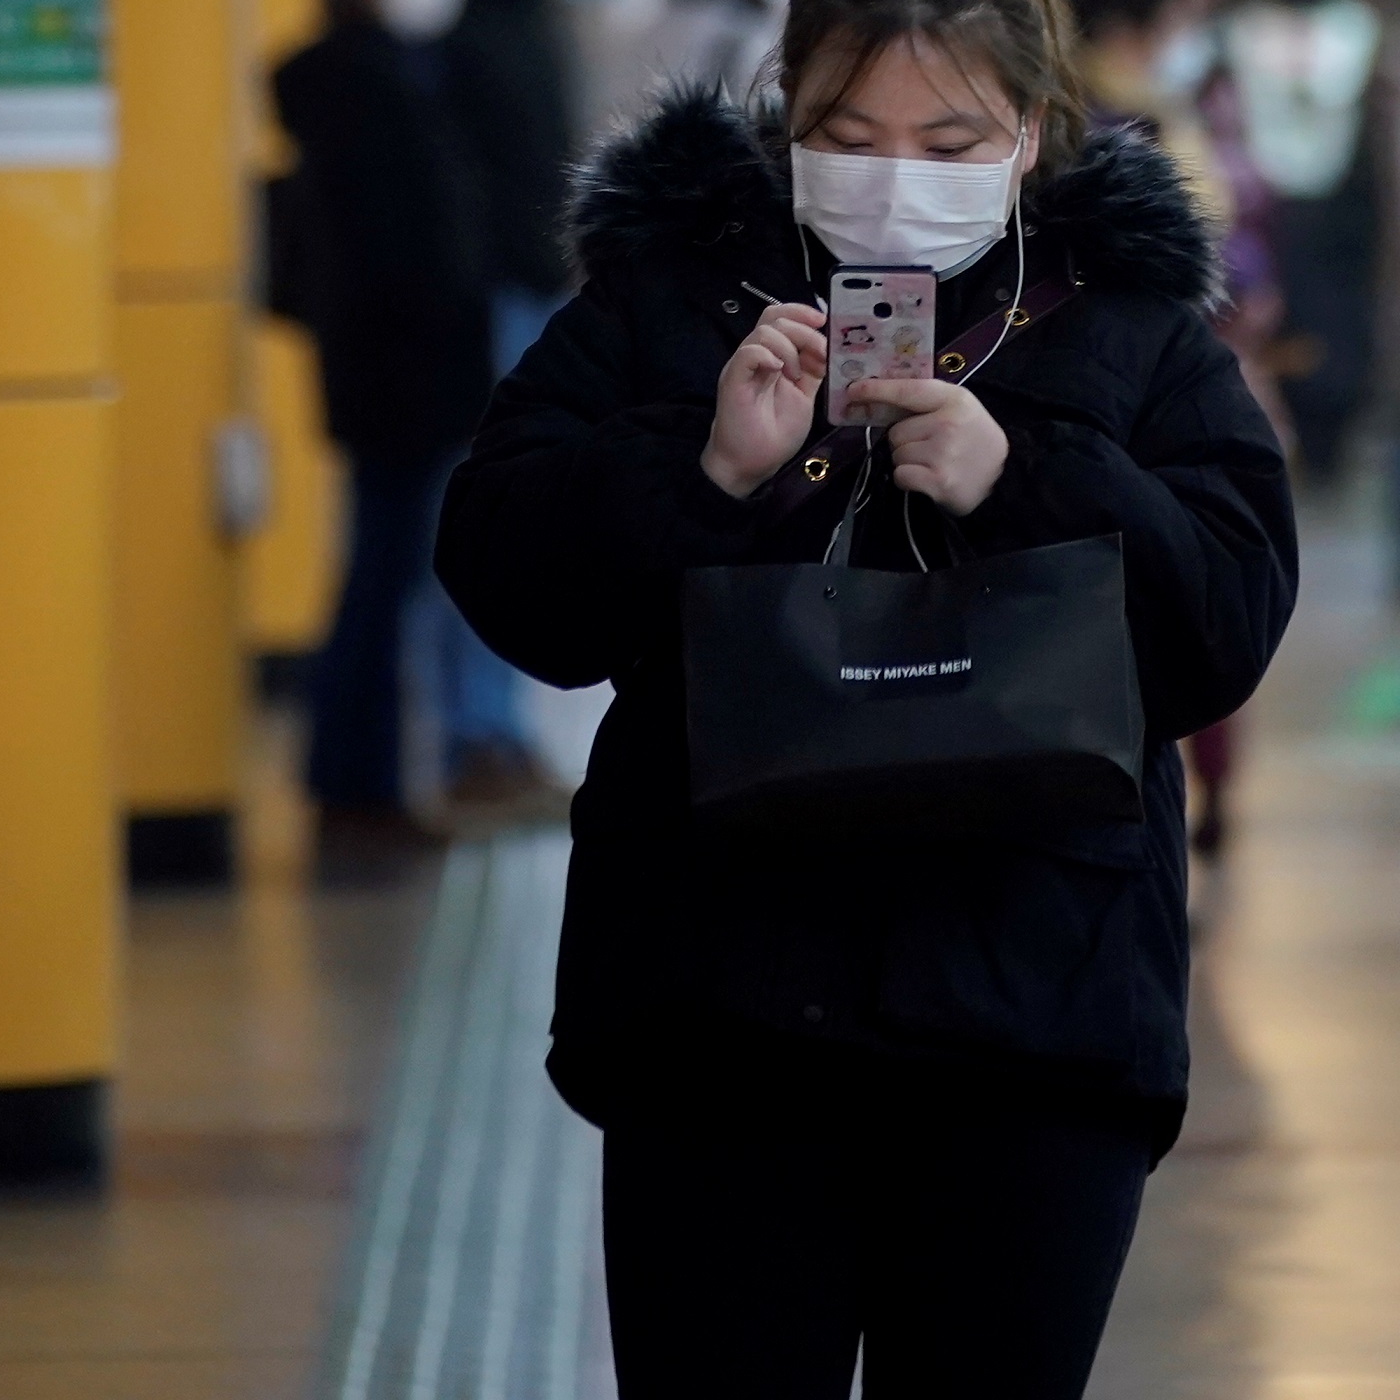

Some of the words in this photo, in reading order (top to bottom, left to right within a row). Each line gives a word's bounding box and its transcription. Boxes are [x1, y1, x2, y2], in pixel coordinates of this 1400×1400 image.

[840, 666, 881, 680] ISSEY
[884, 662, 937, 680] MIYAKE
[940, 658, 972, 675] MEN
